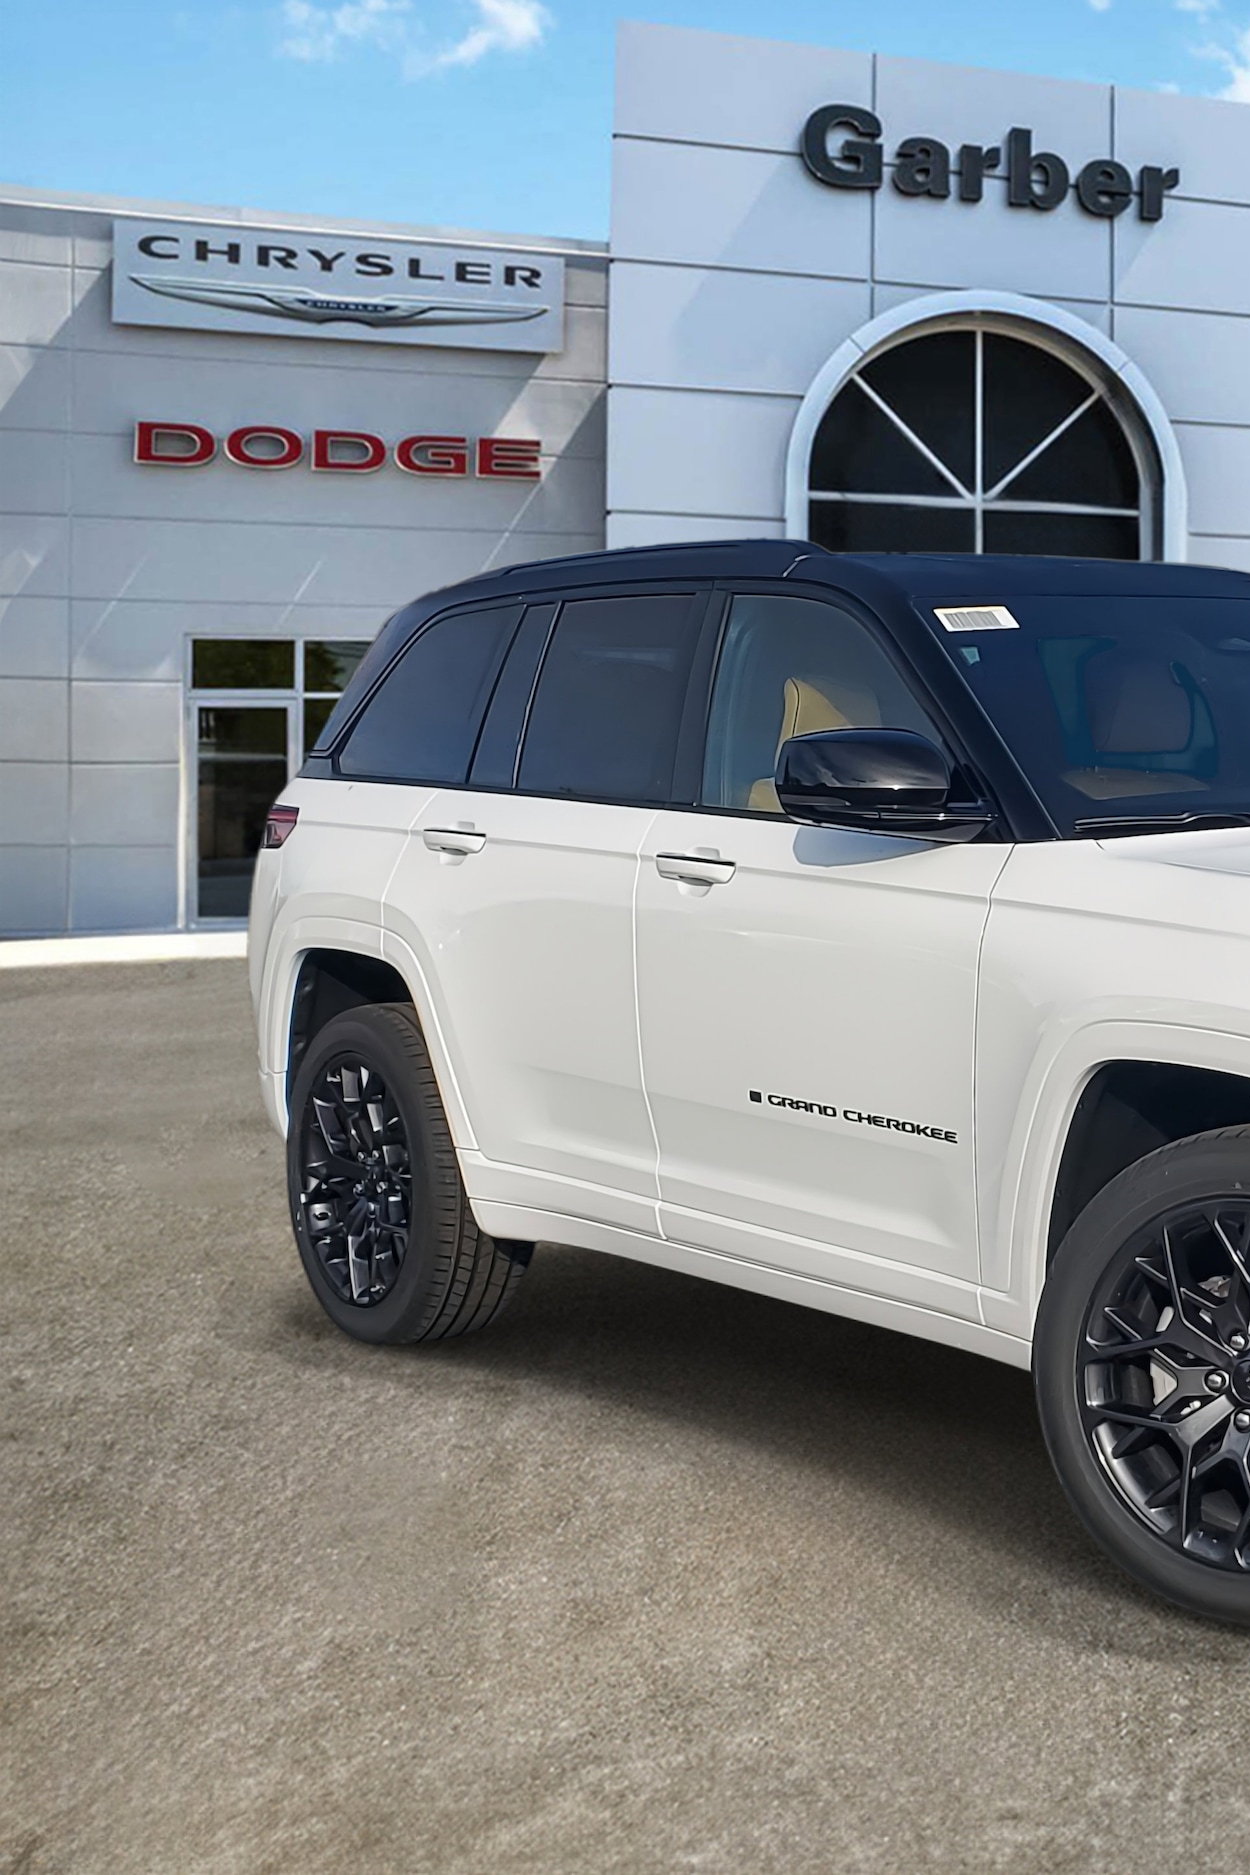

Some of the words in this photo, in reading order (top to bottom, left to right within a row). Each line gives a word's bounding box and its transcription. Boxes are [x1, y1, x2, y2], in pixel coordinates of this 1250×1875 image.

[801, 104, 1180, 222] Garber
[137, 235, 543, 288] CHRYSLER
[133, 420, 543, 480] DODGE
[767, 1094, 837, 1118] GRAND
[843, 1109, 959, 1144] CHEROKEE
